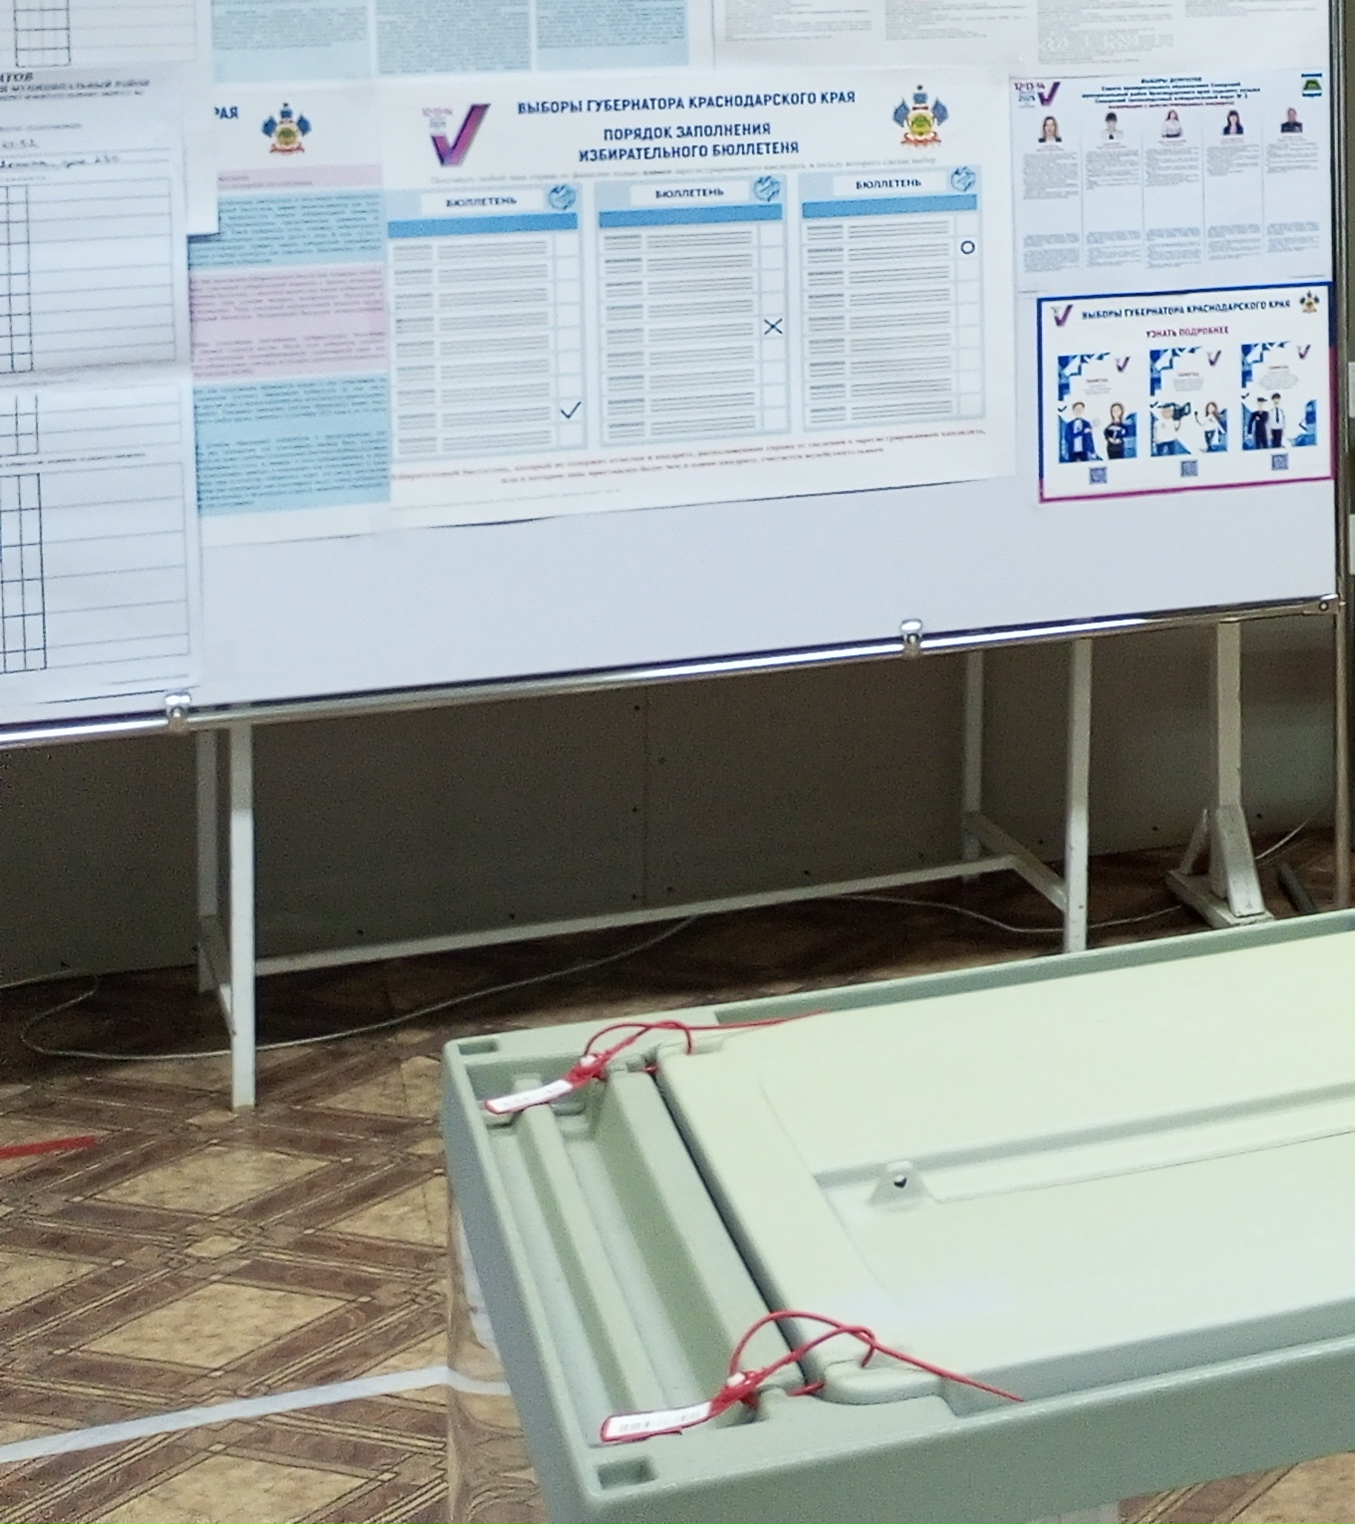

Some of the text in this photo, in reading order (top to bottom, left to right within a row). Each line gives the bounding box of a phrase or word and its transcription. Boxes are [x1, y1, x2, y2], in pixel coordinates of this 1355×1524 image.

[518, 91, 855, 115] ВЫБОРЫ ГУБЕРНАТОРА КРАСНОДАРСКОГО КРАЯ
[604, 122, 771, 141] ПОРЯДОК ЗАПОЛНЕНИЯ
[579, 141, 799, 162] ИЗБИРАТЕЛЬНОГО БЮЛЛЕТЕНЯ
[856, 178, 922, 190] БЮЛЛЕТЕНЬ
[655, 187, 724, 199] БЮЛЛЕТЕНЬ
[446, 196, 518, 208] БЮЛЛЕТЕНЬ
[1124, 305, 1185, 317] ГУБЕРНАТОРА
[1187, 302, 1267, 314] КРАСНОДАРСКОГО
